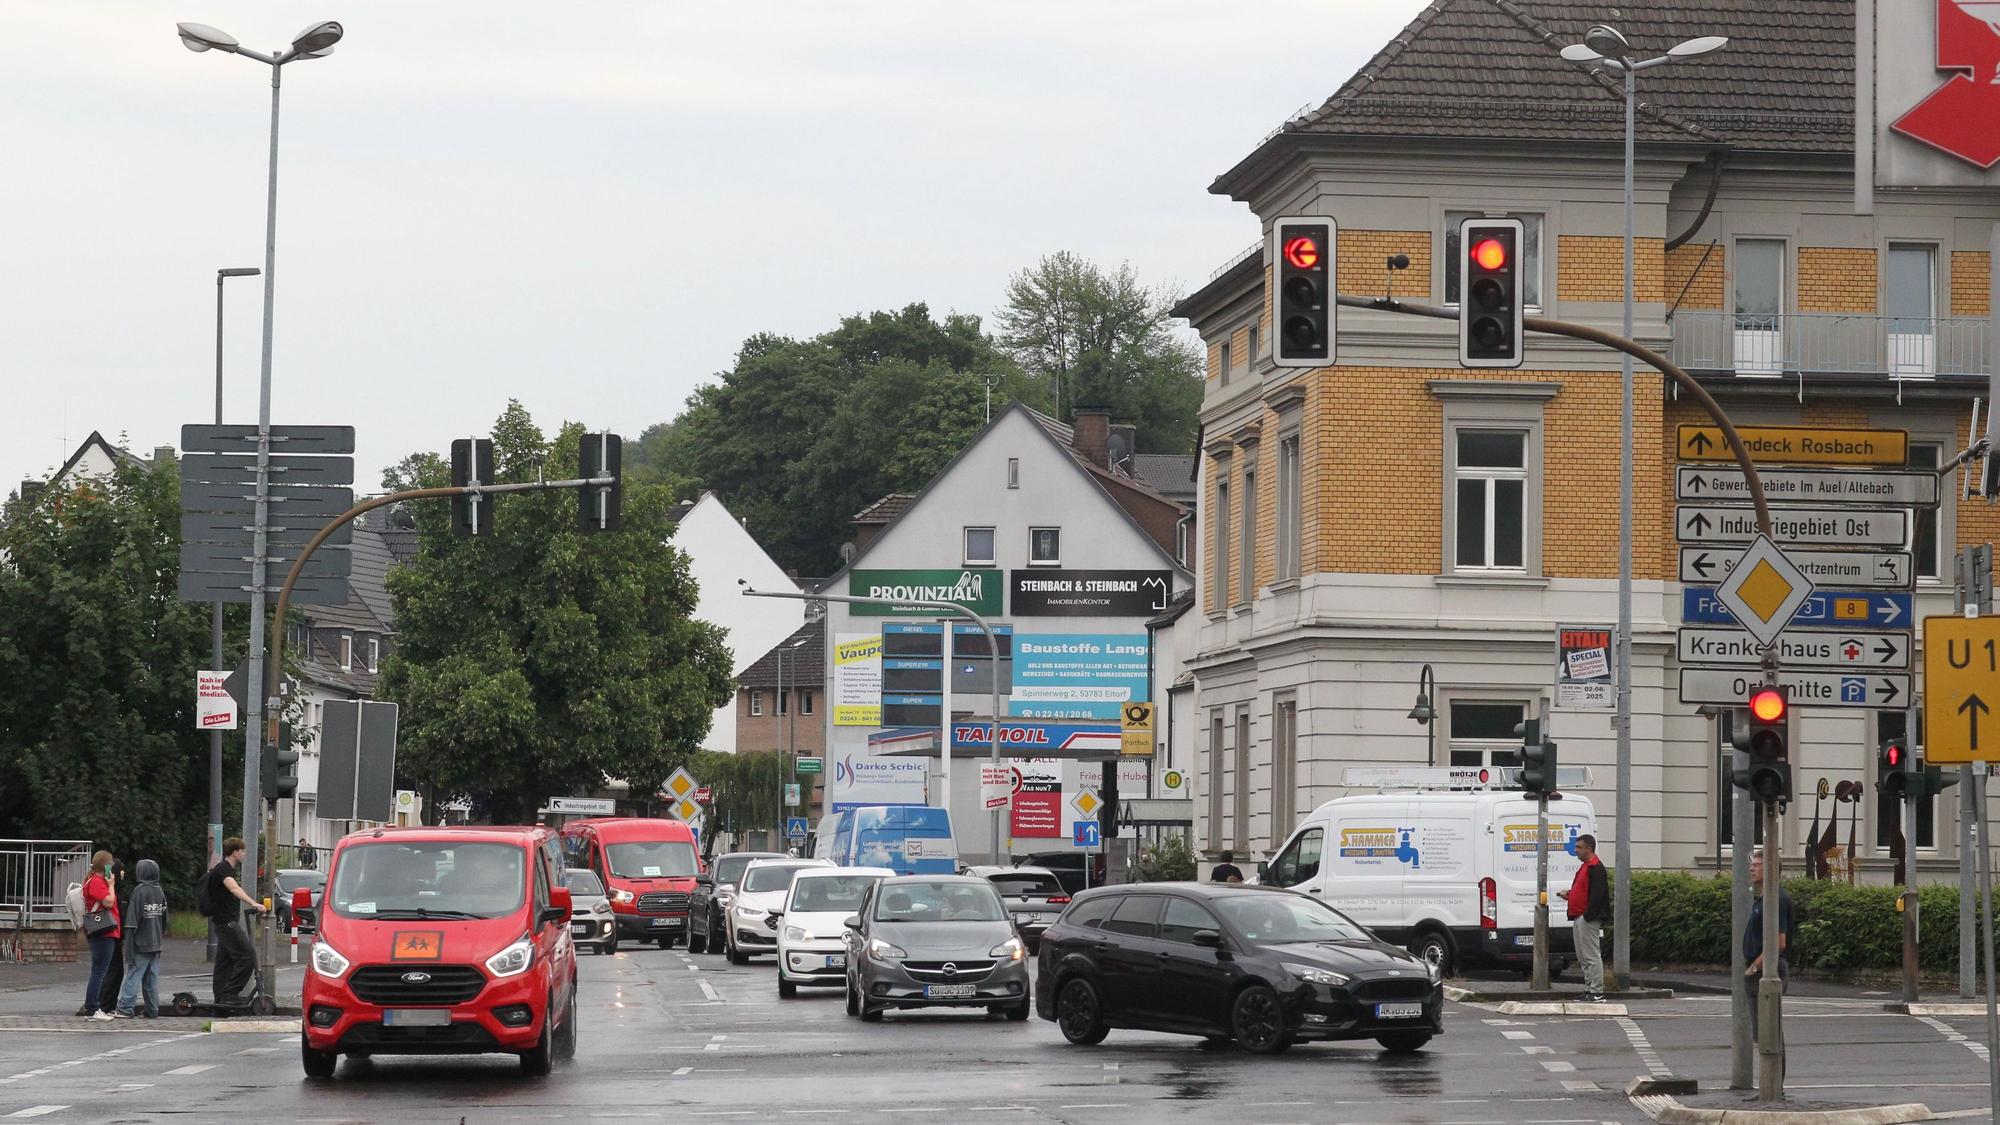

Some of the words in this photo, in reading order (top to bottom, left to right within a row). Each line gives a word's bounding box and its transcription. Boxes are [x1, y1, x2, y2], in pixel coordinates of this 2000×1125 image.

[1722, 436, 1792, 453] Wndeck
[1801, 438, 1874, 455] Rosbach
[1800, 480, 1813, 493] Im
[1846, 518, 1871, 537] Ost
[869, 585, 977, 600] PROVINZIAL
[1020, 580, 1072, 592] STEINBACH
[1075, 581, 1084, 592] &
[1085, 580, 1138, 592] STEINBACH
[1847, 602, 1856, 615] 8
[1561, 632, 1609, 648] EITALK
[1021, 643, 1101, 654] Baustoffe
[1691, 637, 1831, 658] Krankehaus
[1570, 651, 1602, 662] SPECIAL
[1022, 689, 1069, 698] Spinnerweg
[1079, 689, 1103, 698] 53783
[1104, 689, 1127, 698] Eitorf
[956, 728, 1050, 743] TAMOIL
[856, 763, 887, 771] Darko
[1123, 772, 1150, 781] Hube
[408, 973, 425, 981] Ford
